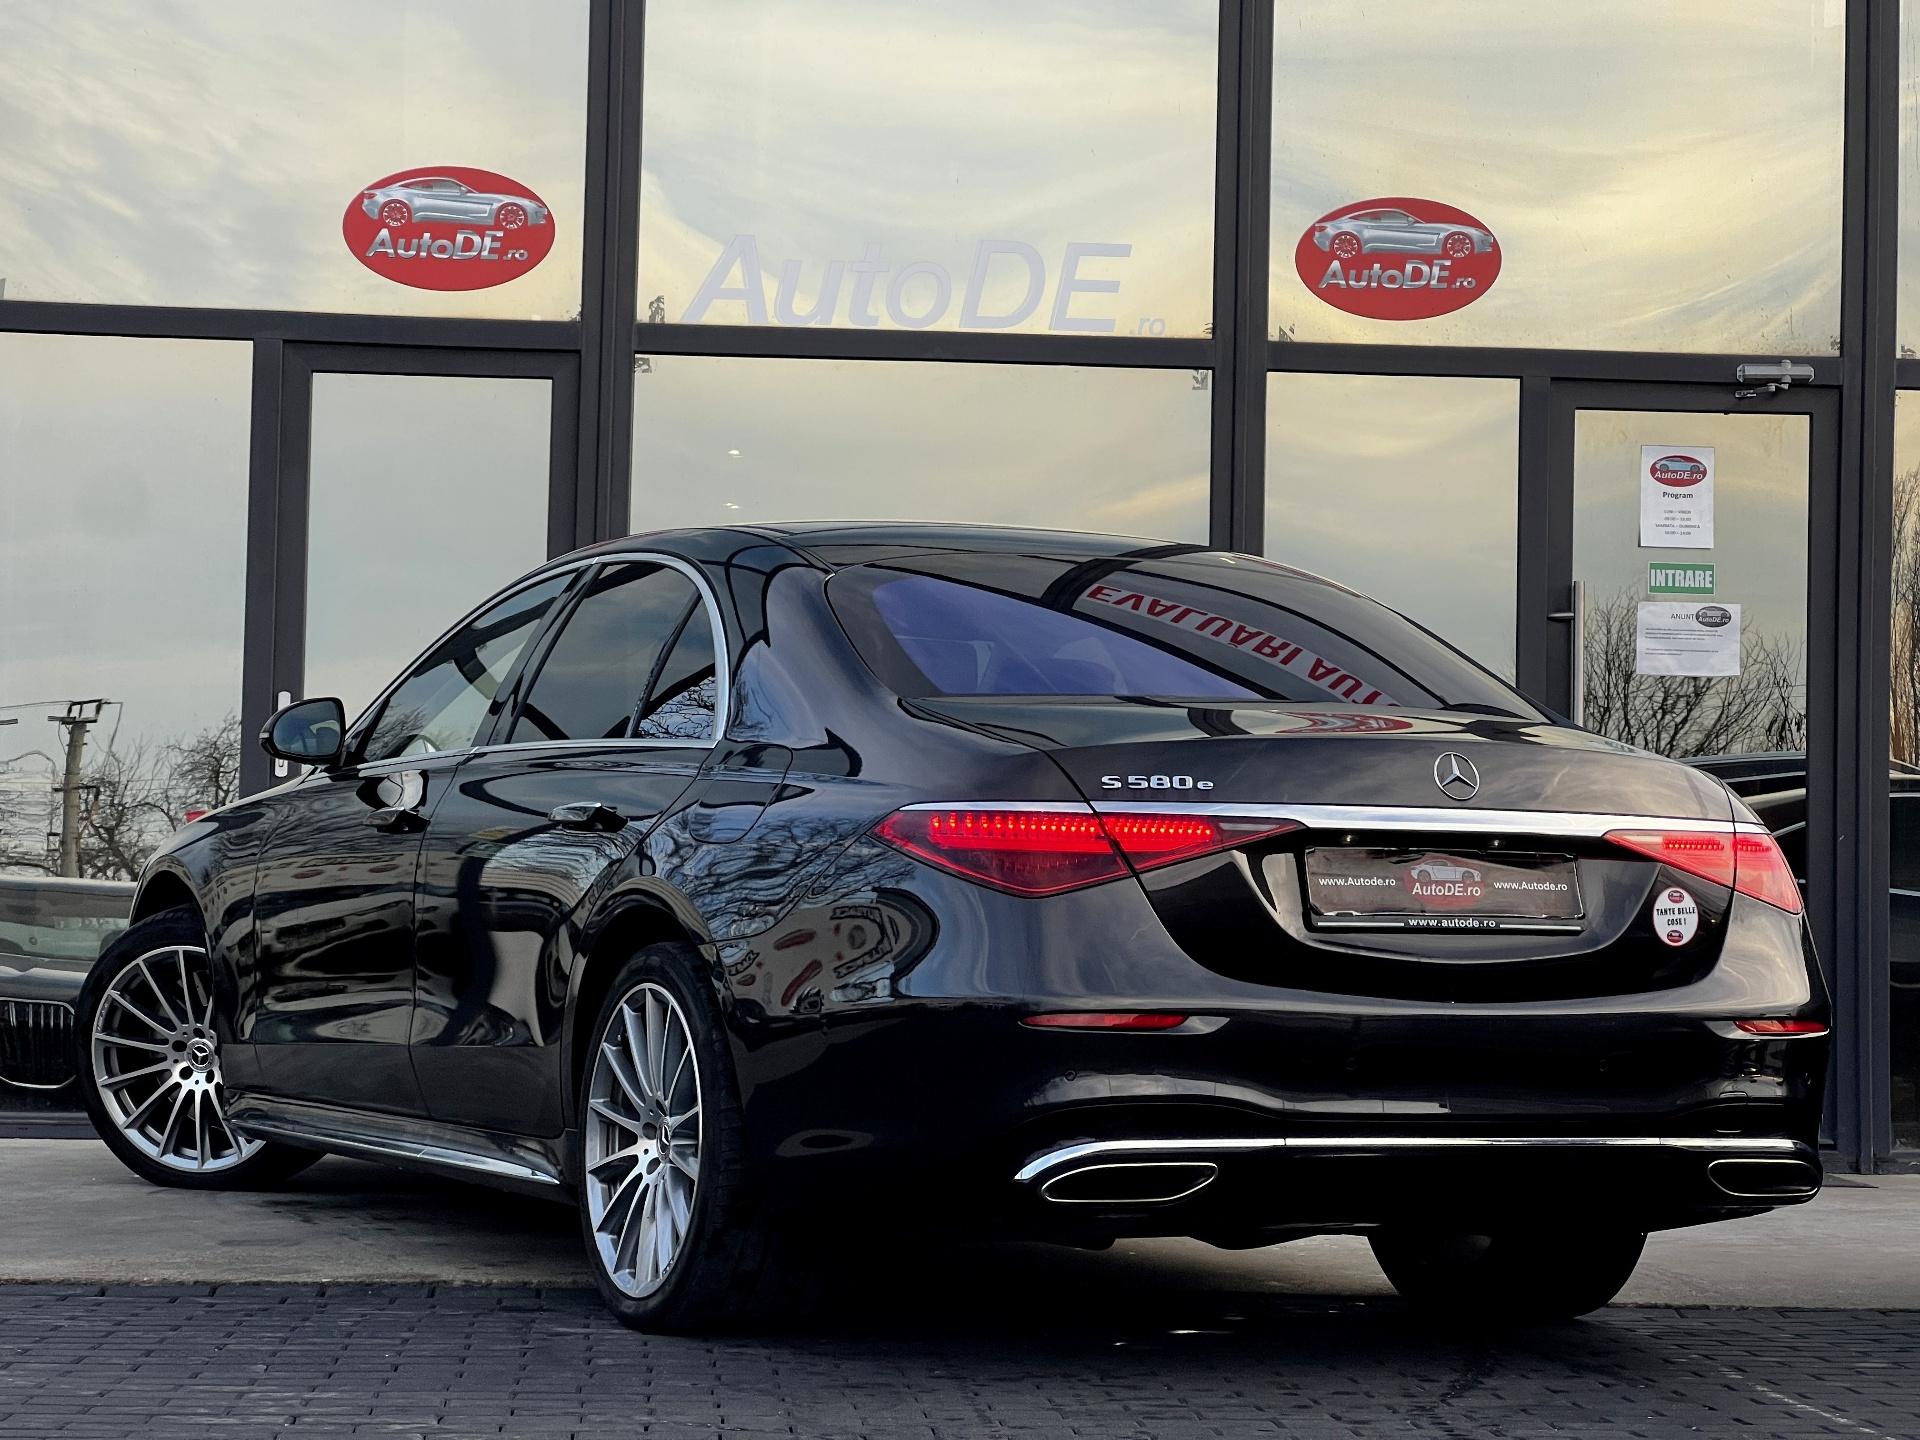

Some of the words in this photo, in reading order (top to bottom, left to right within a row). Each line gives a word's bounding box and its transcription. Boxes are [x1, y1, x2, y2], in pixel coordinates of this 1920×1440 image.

[1662, 491, 1694, 499] Program
[1650, 569, 1713, 588] INTRARE
[1318, 876, 1396, 886] www.Autode.ro
[1493, 881, 1568, 891] www.Autode.ro
[1411, 883, 1481, 897] AutoDE.ro
[1656, 907, 1676, 916] TANTE
[1408, 917, 1496, 928] www.autode.ro
